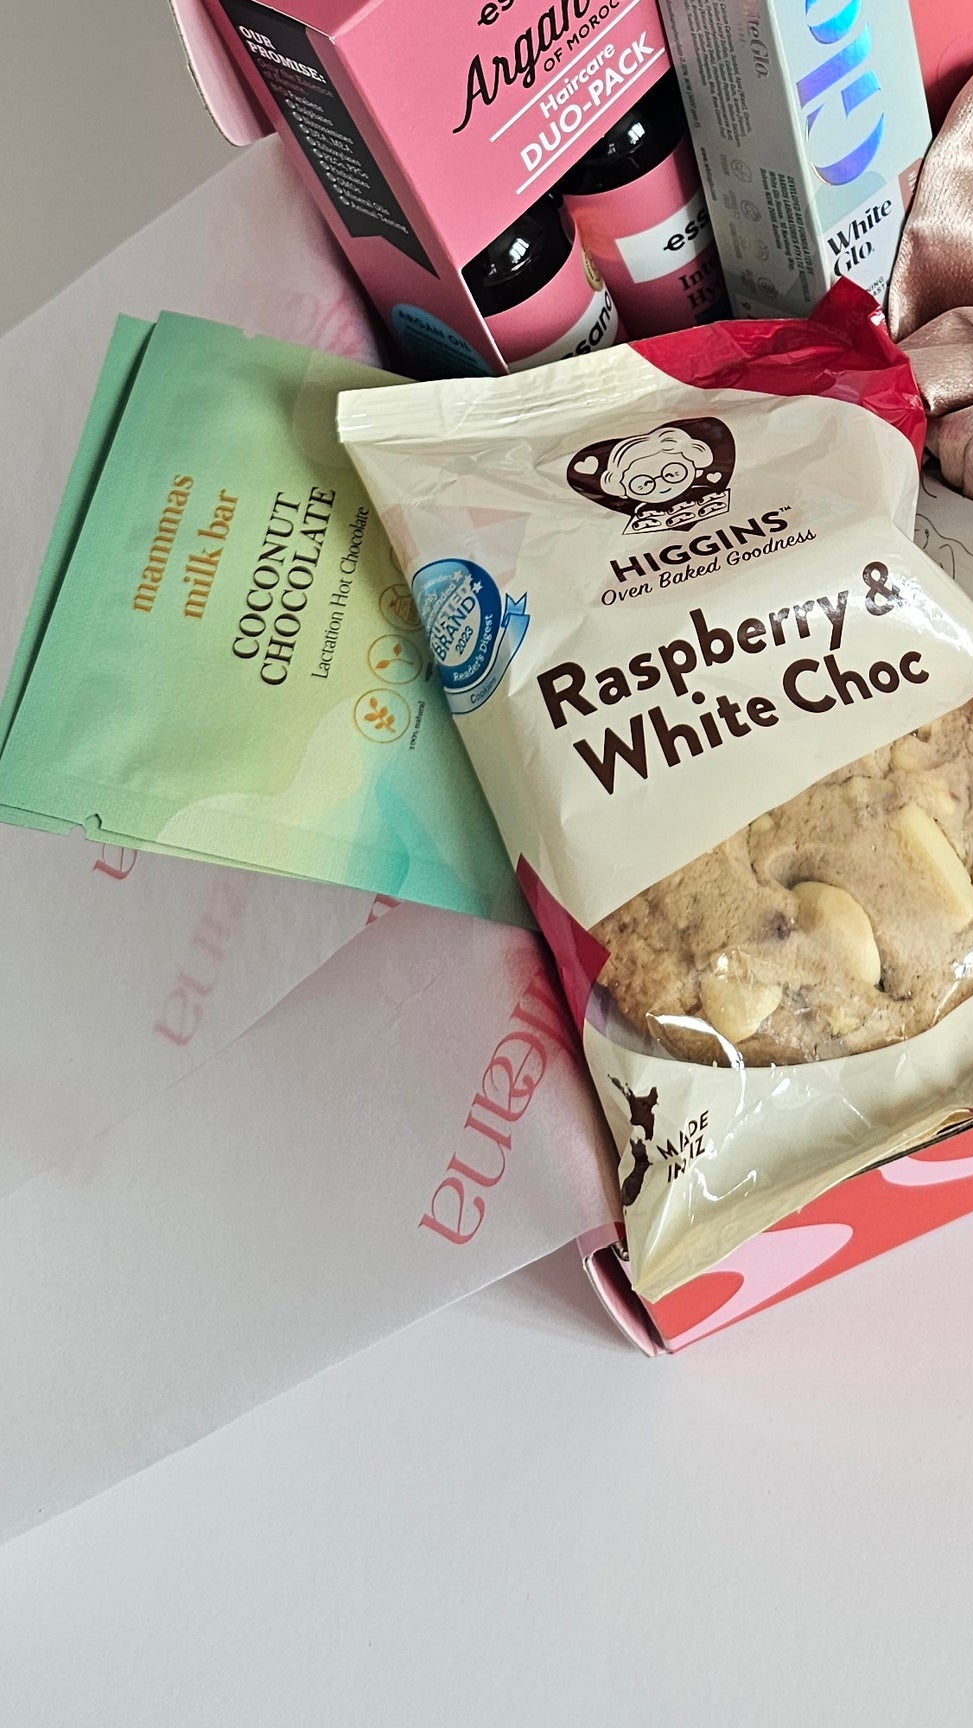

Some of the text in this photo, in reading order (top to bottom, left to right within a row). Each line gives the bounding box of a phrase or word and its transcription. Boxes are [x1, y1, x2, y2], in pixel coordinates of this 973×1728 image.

[238, 24, 277, 51] OUR
[247, 40, 327, 84] PROMISE:
[543, 48, 567, 74] OF
[520, 30, 656, 173] DUO-PACK
[539, 41, 617, 118] Haircare
[663, 209, 710, 252] ess
[826, 199, 893, 257] White
[560, 290, 613, 361] sano
[132, 473, 194, 614] mammas
[183, 488, 240, 620] milk bar
[232, 491, 301, 660] COCONUT
[600, 528, 818, 607] Oven Baked Goodness
[259, 486, 336, 686] CHOCOLATE
[311, 506, 370, 679] Lactation Hot Chocolate
[433, 595, 477, 662] BRAND
[453, 613, 494, 682] Reader's Digest
[455, 625, 474, 656] 2023
[537, 561, 902, 730] Raspberry &
[573, 650, 930, 796] White Choc
